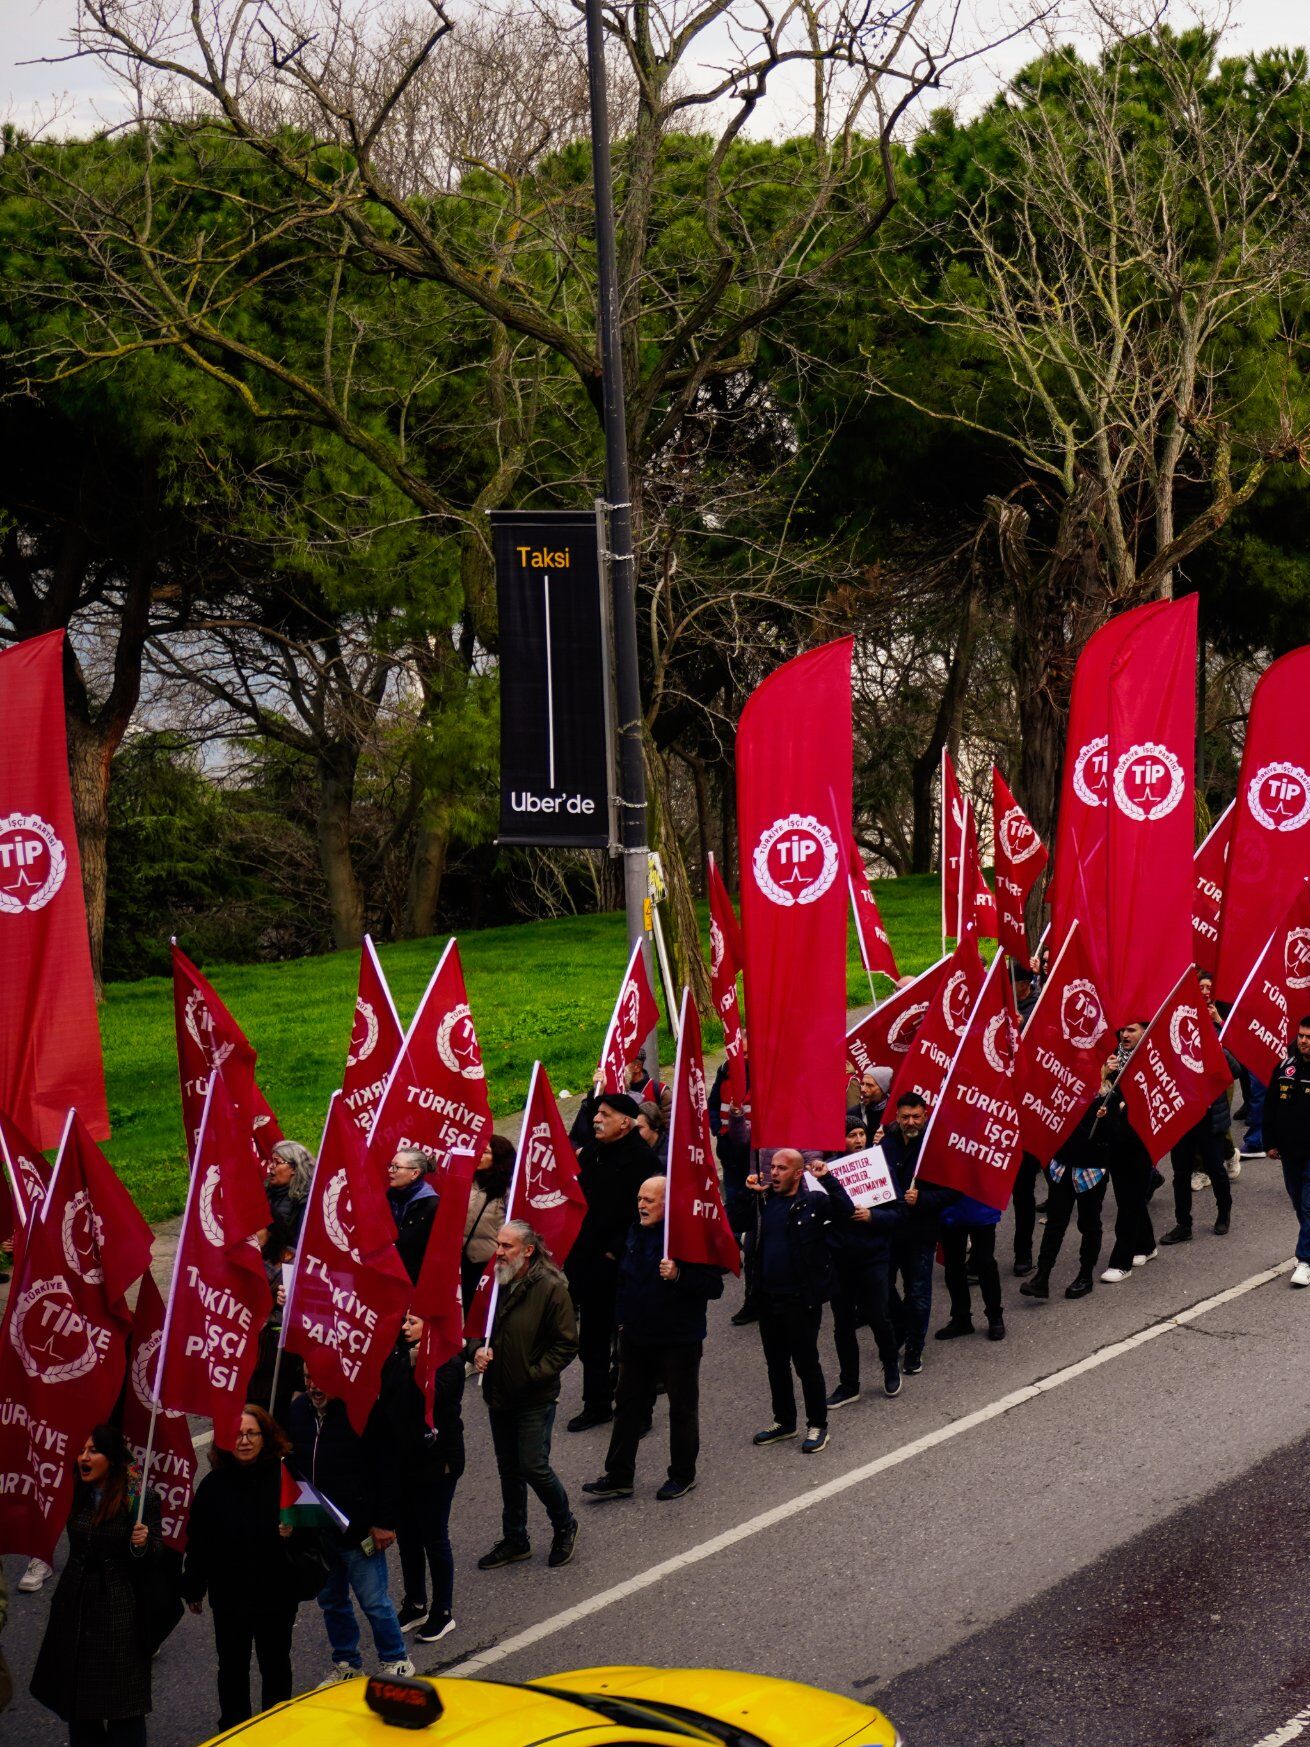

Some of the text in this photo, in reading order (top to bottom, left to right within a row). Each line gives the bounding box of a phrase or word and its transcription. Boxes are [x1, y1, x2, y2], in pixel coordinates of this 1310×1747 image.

[517, 547, 570, 568] Taksi
[1091, 751, 1108, 774] Tİ
[1131, 760, 1165, 785] TİP
[511, 792, 595, 815] Uber'de
[1268, 778, 1301, 801] TİP
[1010, 819, 1033, 839] TİP
[0, 836, 44, 868] TİP
[776, 835, 817, 865] TİP
[1075, 992, 1097, 1018] TİP
[1034, 1046, 1085, 1096] TÜRKİYE
[1146, 1038, 1185, 1112] TÜRKİYE
[406, 1085, 486, 1134] TÜRKİYE
[956, 1084, 1020, 1127] TÜRKİY
[1050, 1083, 1077, 1113] İŞÇİ
[1150, 1085, 1175, 1124] İŞÇİ
[438, 1121, 478, 1151] İŞÇİ
[984, 1117, 1020, 1148] İŞÇİ
[947, 1132, 1012, 1171] PARTİSİ
[848, 1177, 887, 1198] UNUTMAYIN!
[24, 1281, 63, 1305] TÜRKİYE
[40, 1299, 85, 1338] TİP
[332, 1310, 373, 1356] İŞÇİ
[204, 1315, 248, 1360] İŞÇİ
[0, 1397, 69, 1456] ÜRKİYE
[0, 1472, 55, 1520] ARTİSİ
